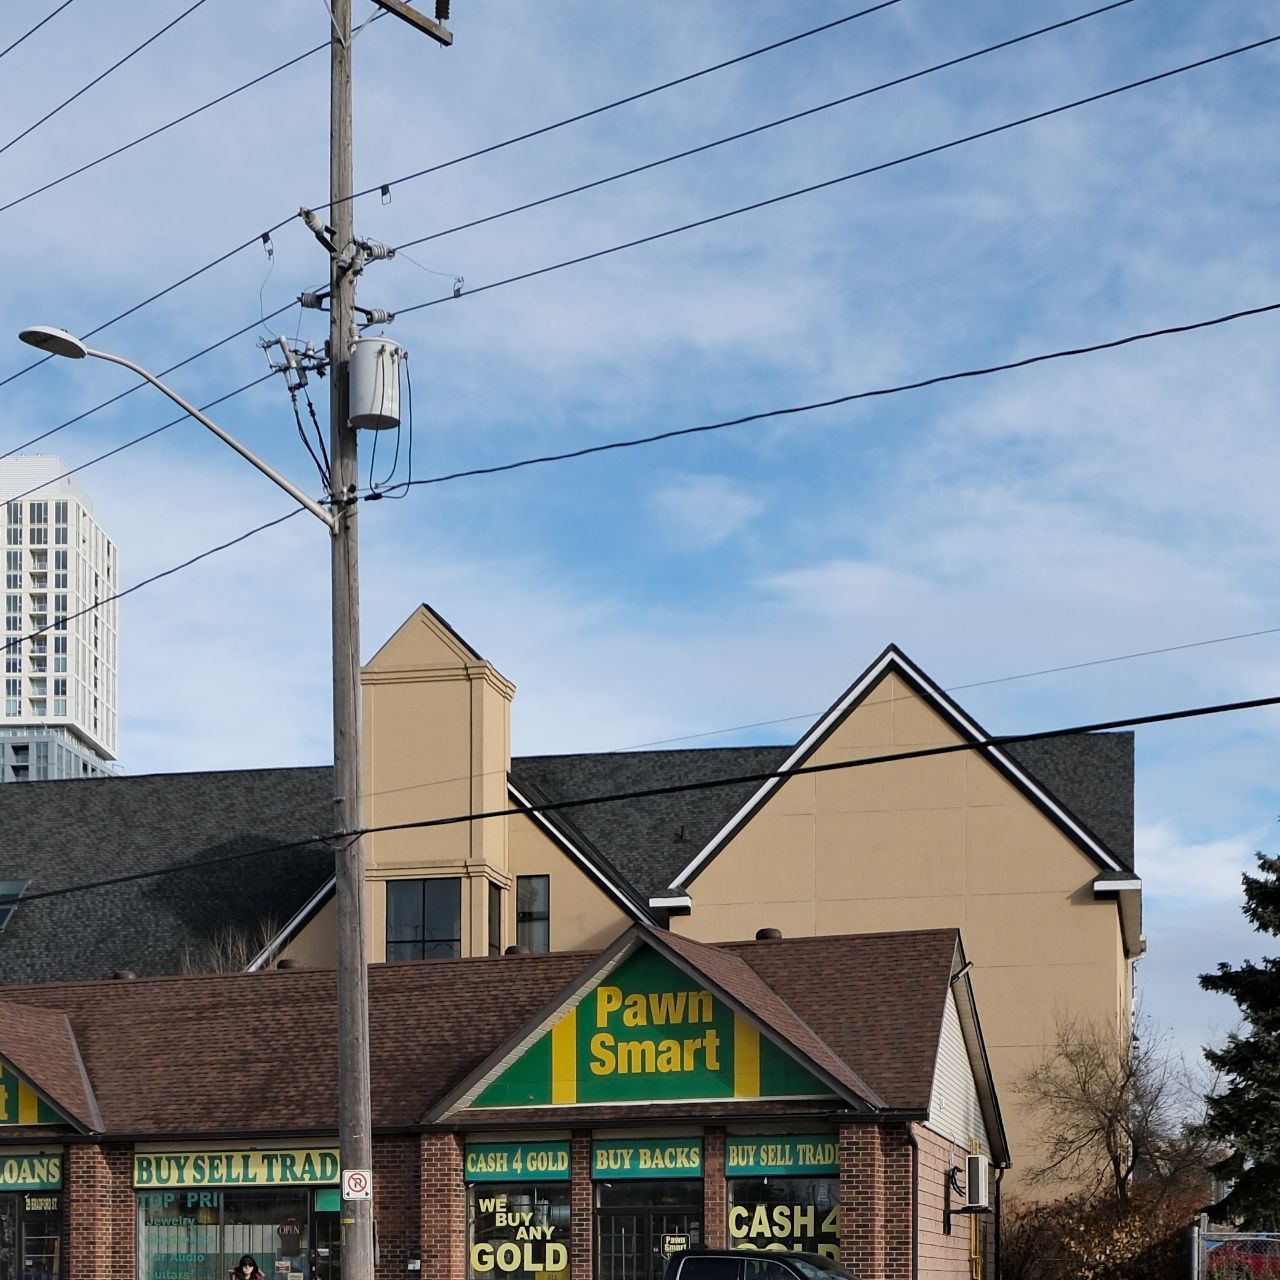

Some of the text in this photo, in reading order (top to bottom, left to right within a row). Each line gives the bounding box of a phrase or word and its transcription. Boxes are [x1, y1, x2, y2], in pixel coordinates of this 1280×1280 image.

[596, 986, 713, 1028] Pawn
[589, 1029, 720, 1076] Smart
[466, 1148, 569, 1174] CASH 4 GOLD
[596, 1147, 700, 1170] BUY BACKS
[728, 1145, 757, 1167] BUY
[760, 1144, 793, 1166] SELL
[136, 1156, 191, 1185] BUY
[192, 1154, 257, 1184] SELL
[138, 1192, 175, 1208] TOP
[478, 1198, 507, 1213] WE
[146, 1216, 196, 1229] Jewelry
[495, 1212, 534, 1227] BUY
[728, 1205, 841, 1239] CASH 4
[279, 1225, 300, 1235] OPEN
[516, 1226, 556, 1240] ANY
[665, 1236, 687, 1244] Pawn
[169, 1253, 205, 1263] Audio
[470, 1242, 569, 1273] GOLD
